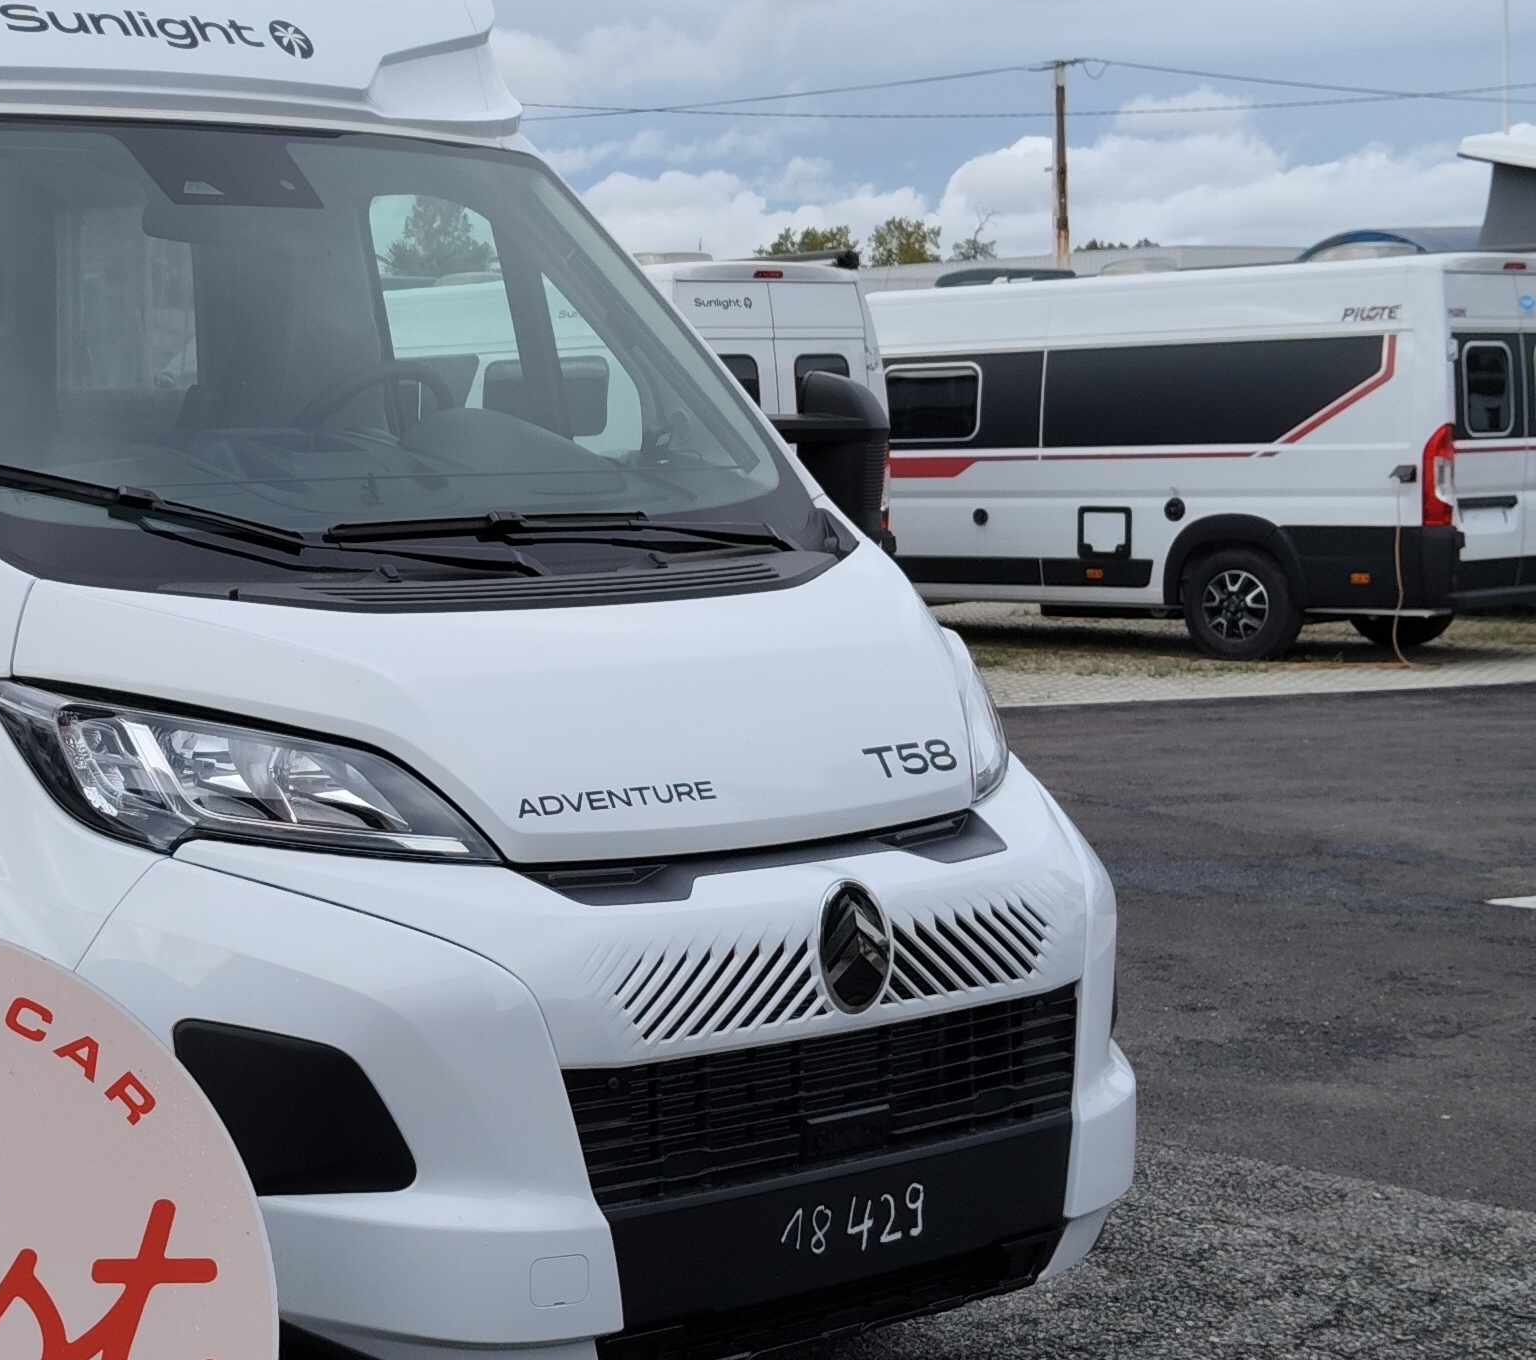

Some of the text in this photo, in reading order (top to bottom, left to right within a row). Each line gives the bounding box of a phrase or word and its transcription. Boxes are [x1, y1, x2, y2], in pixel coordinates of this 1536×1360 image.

[693, 297, 742, 310] Sunlight
[1341, 304, 1402, 322] PILOTE
[861, 738, 958, 779] T58
[518, 780, 718, 819] ADVENTURE
